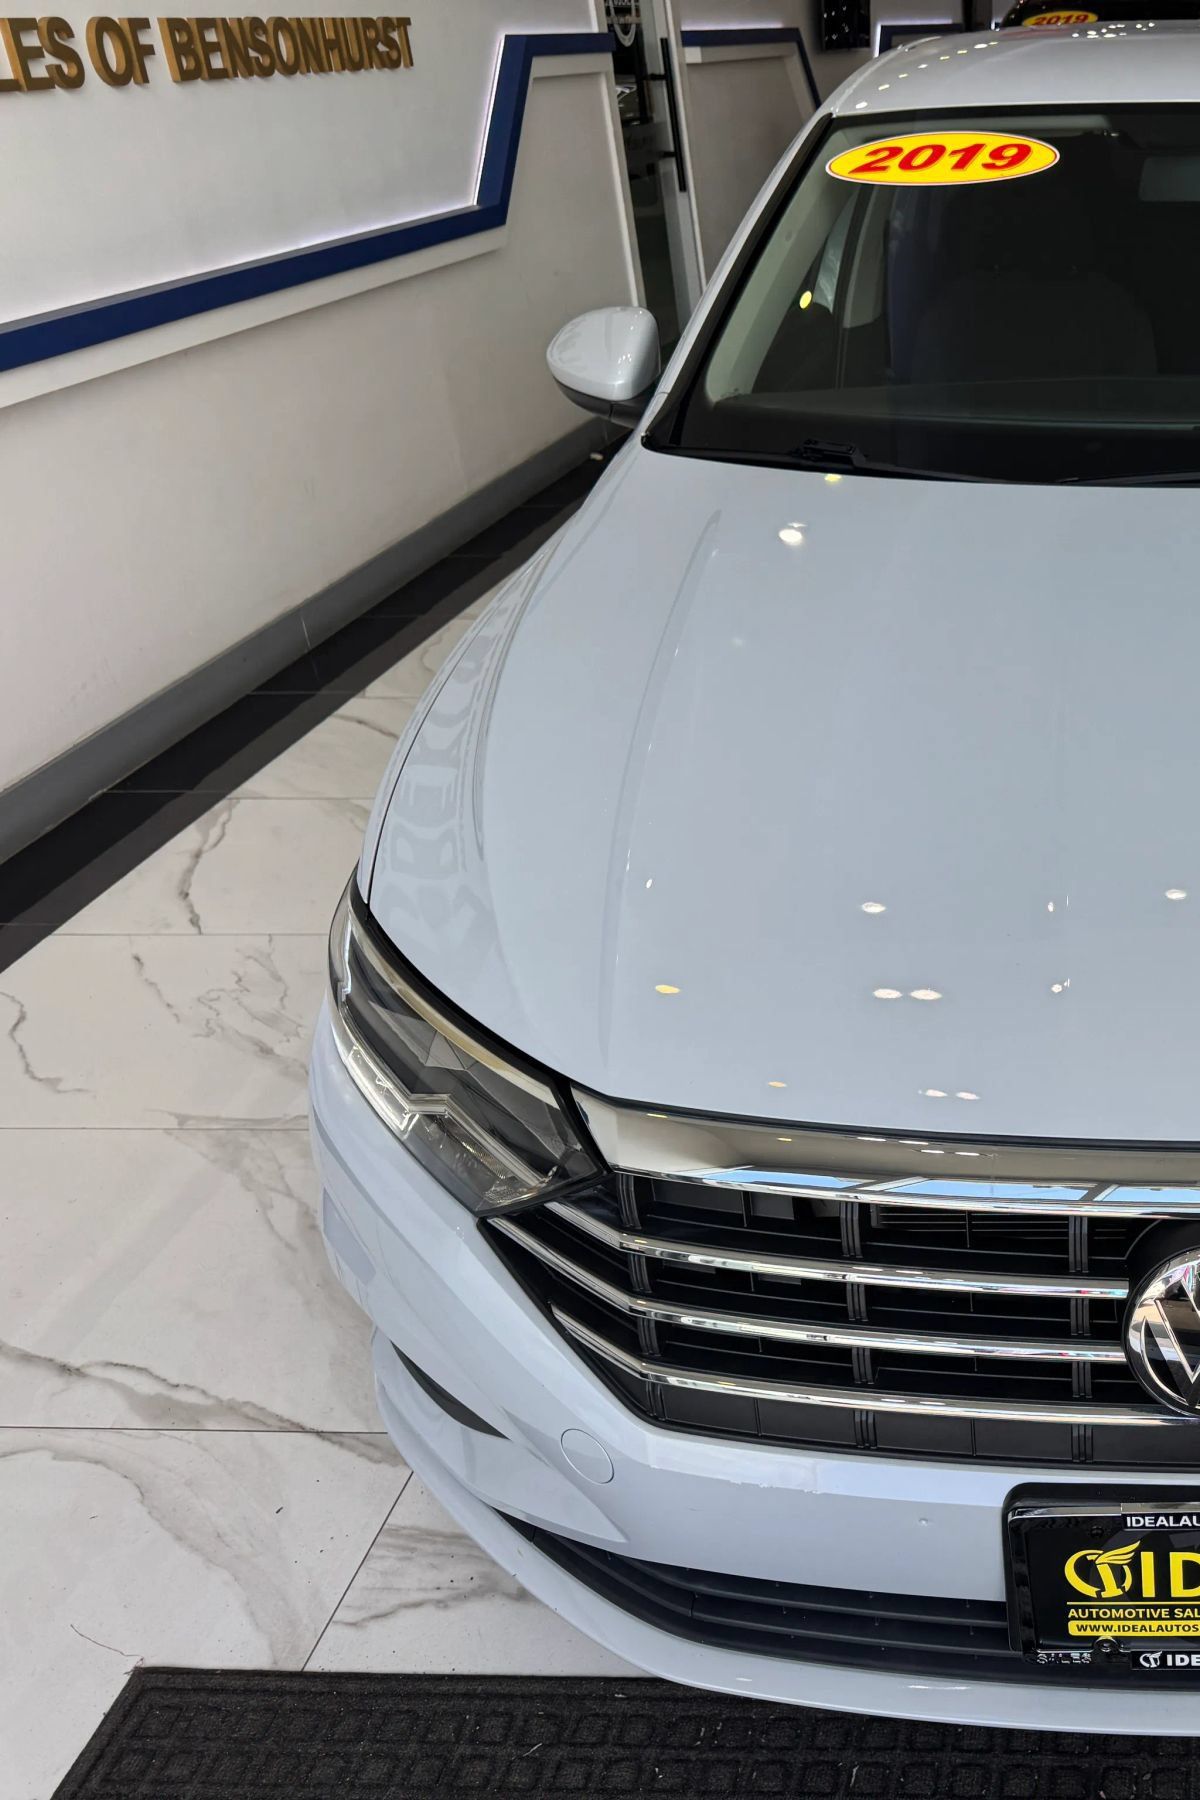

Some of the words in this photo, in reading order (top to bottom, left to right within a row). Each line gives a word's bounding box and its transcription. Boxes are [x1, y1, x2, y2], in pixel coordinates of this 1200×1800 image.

[1031, 13, 1090, 25] 2019
[86, 16, 155, 86] OF
[157, 16, 414, 83] BENSONHURST
[848, 143, 1033, 174] 2019
[1068, 1607, 1170, 1619] AUTOMOTIVE
